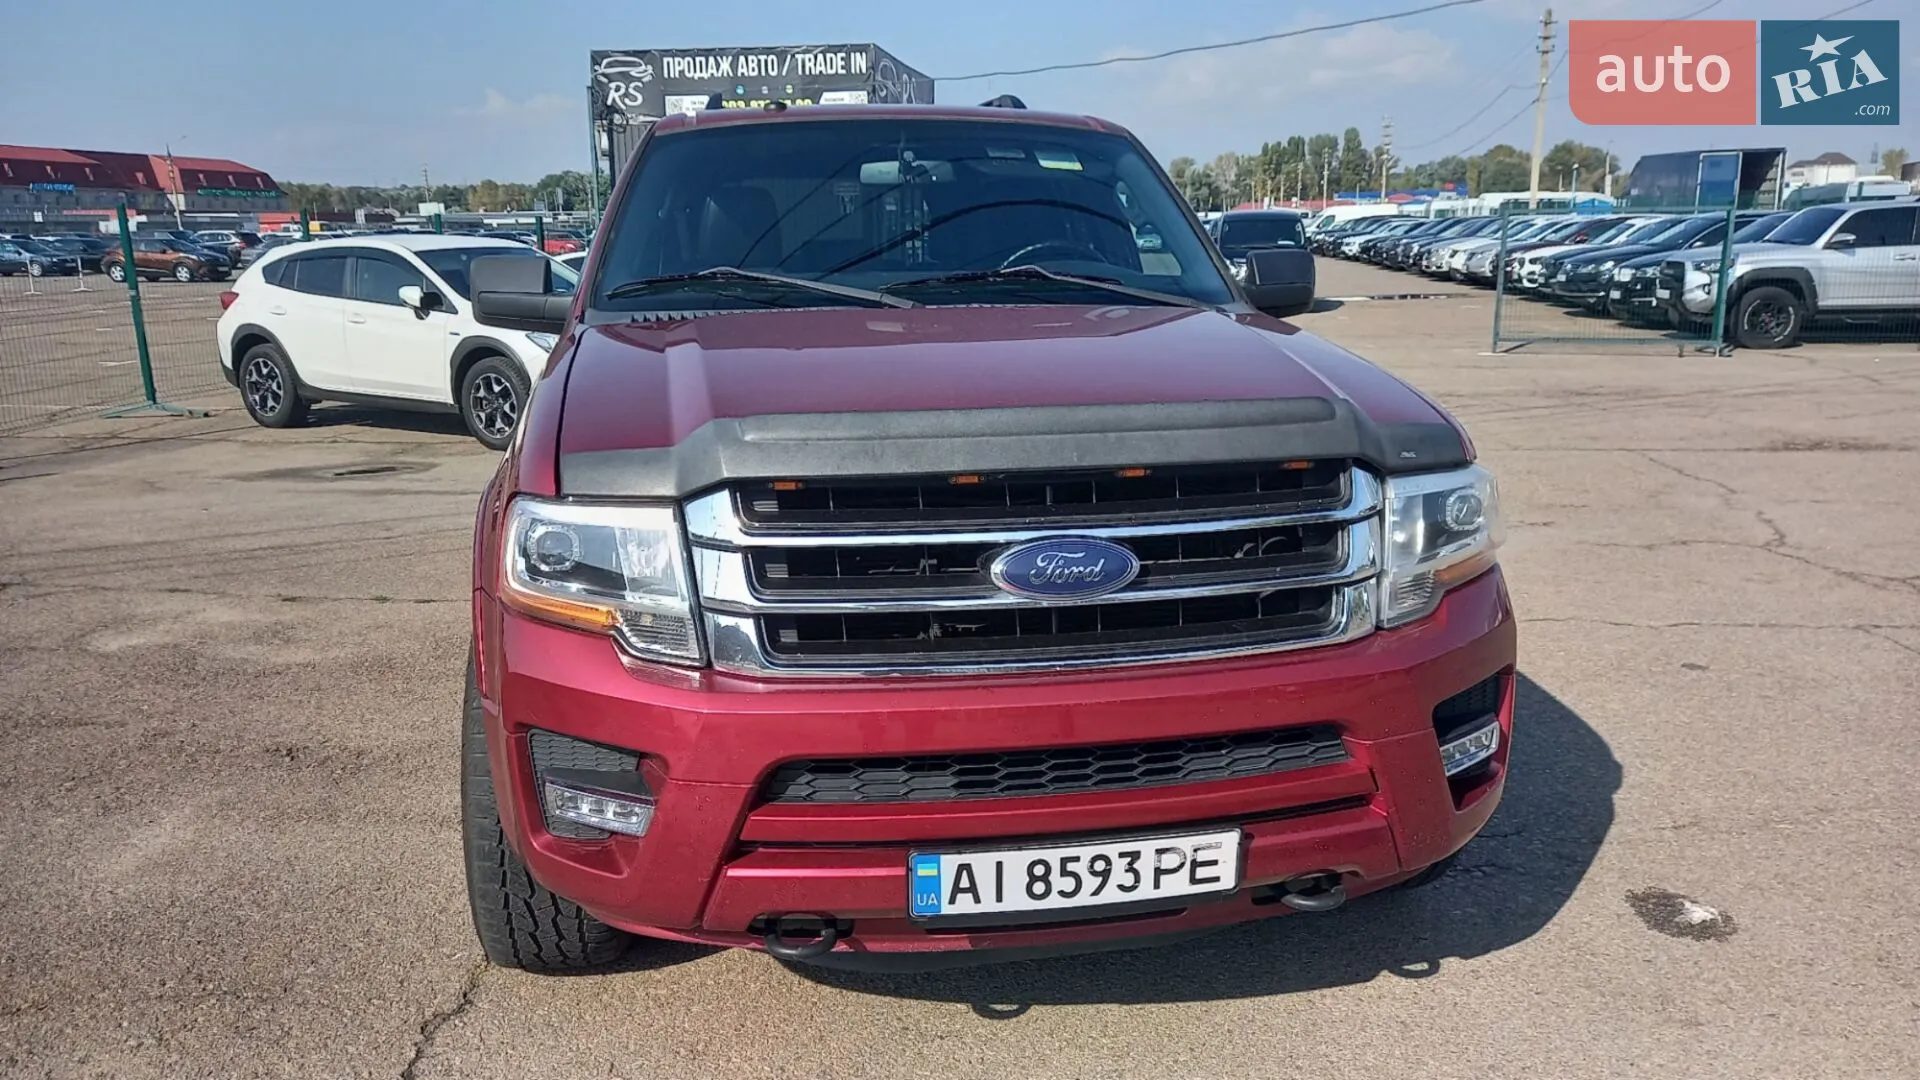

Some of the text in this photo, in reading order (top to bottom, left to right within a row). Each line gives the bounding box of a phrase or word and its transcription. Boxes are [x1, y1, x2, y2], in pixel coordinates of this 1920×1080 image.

[662, 55, 733, 81] ПРОДАЖ
[737, 54, 778, 78] АВТО
[795, 52, 847, 76] TRADE
[850, 51, 867, 74] IN
[606, 81, 643, 111] RS
[1030, 551, 1105, 583] Ford
[948, 841, 1223, 906] AI 8593 PE
[916, 892, 939, 907] UA
